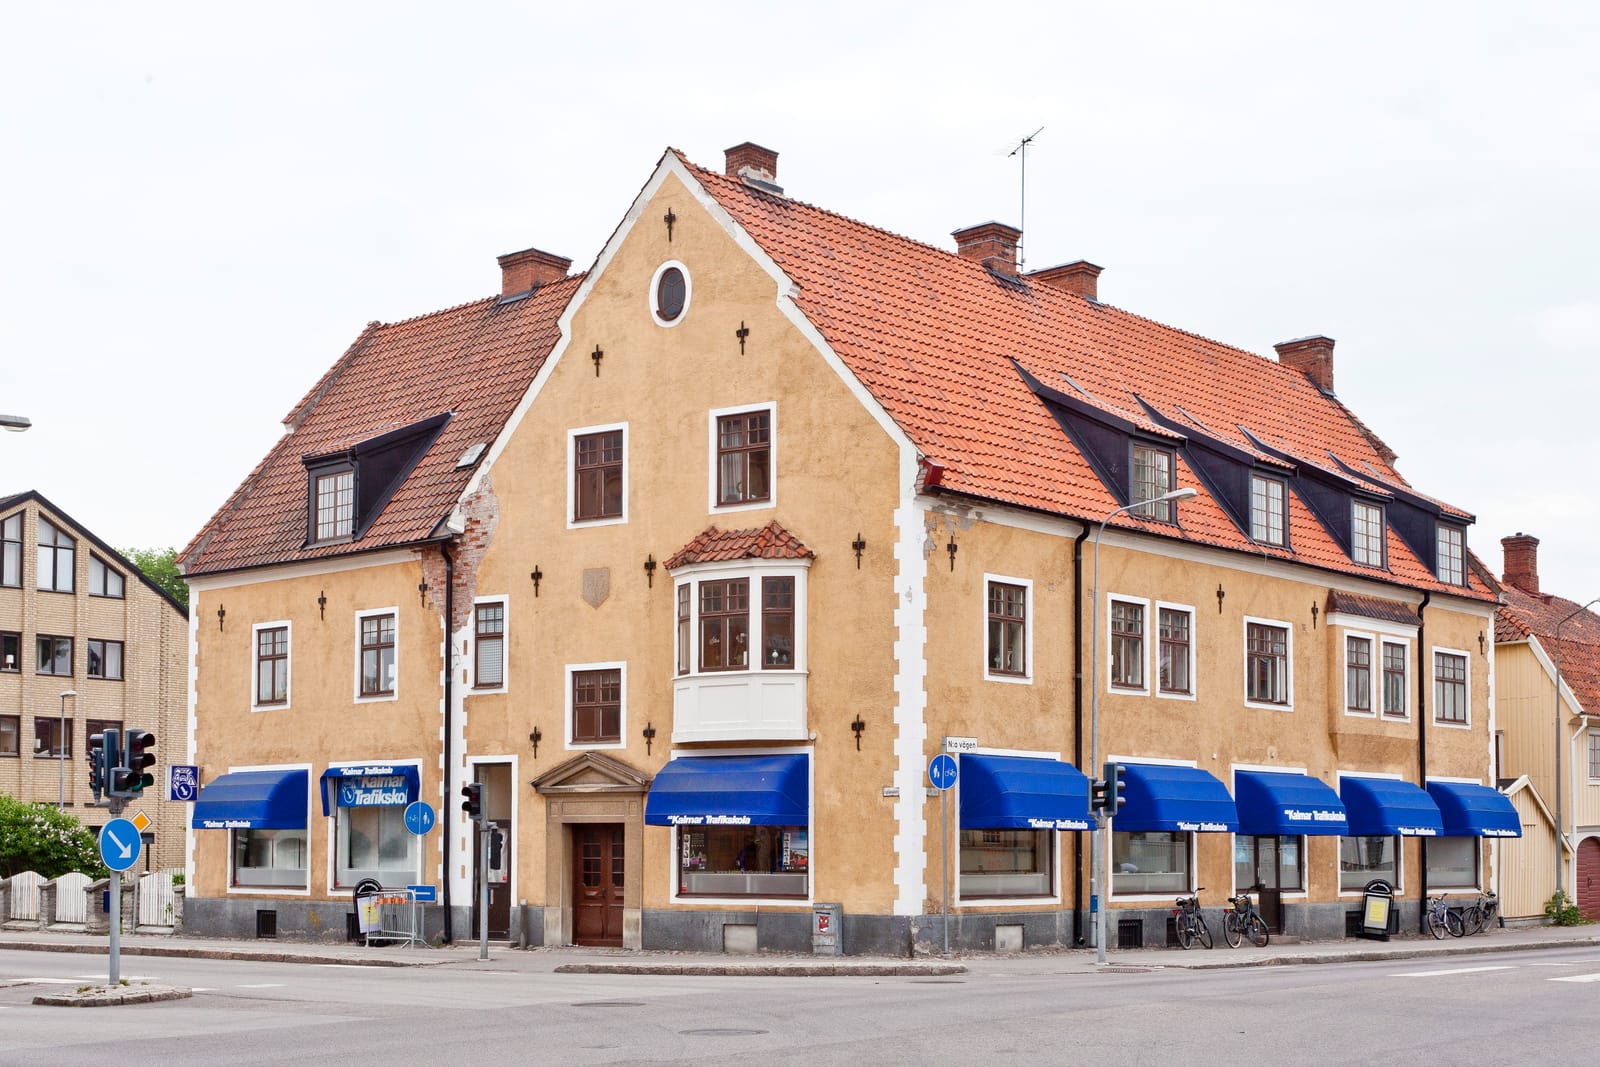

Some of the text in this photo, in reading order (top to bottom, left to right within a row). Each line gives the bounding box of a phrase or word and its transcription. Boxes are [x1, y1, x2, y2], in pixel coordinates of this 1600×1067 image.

[355, 788, 408, 805] Trafikskol
[669, 815, 751, 825] Kalmar Trafikskola
